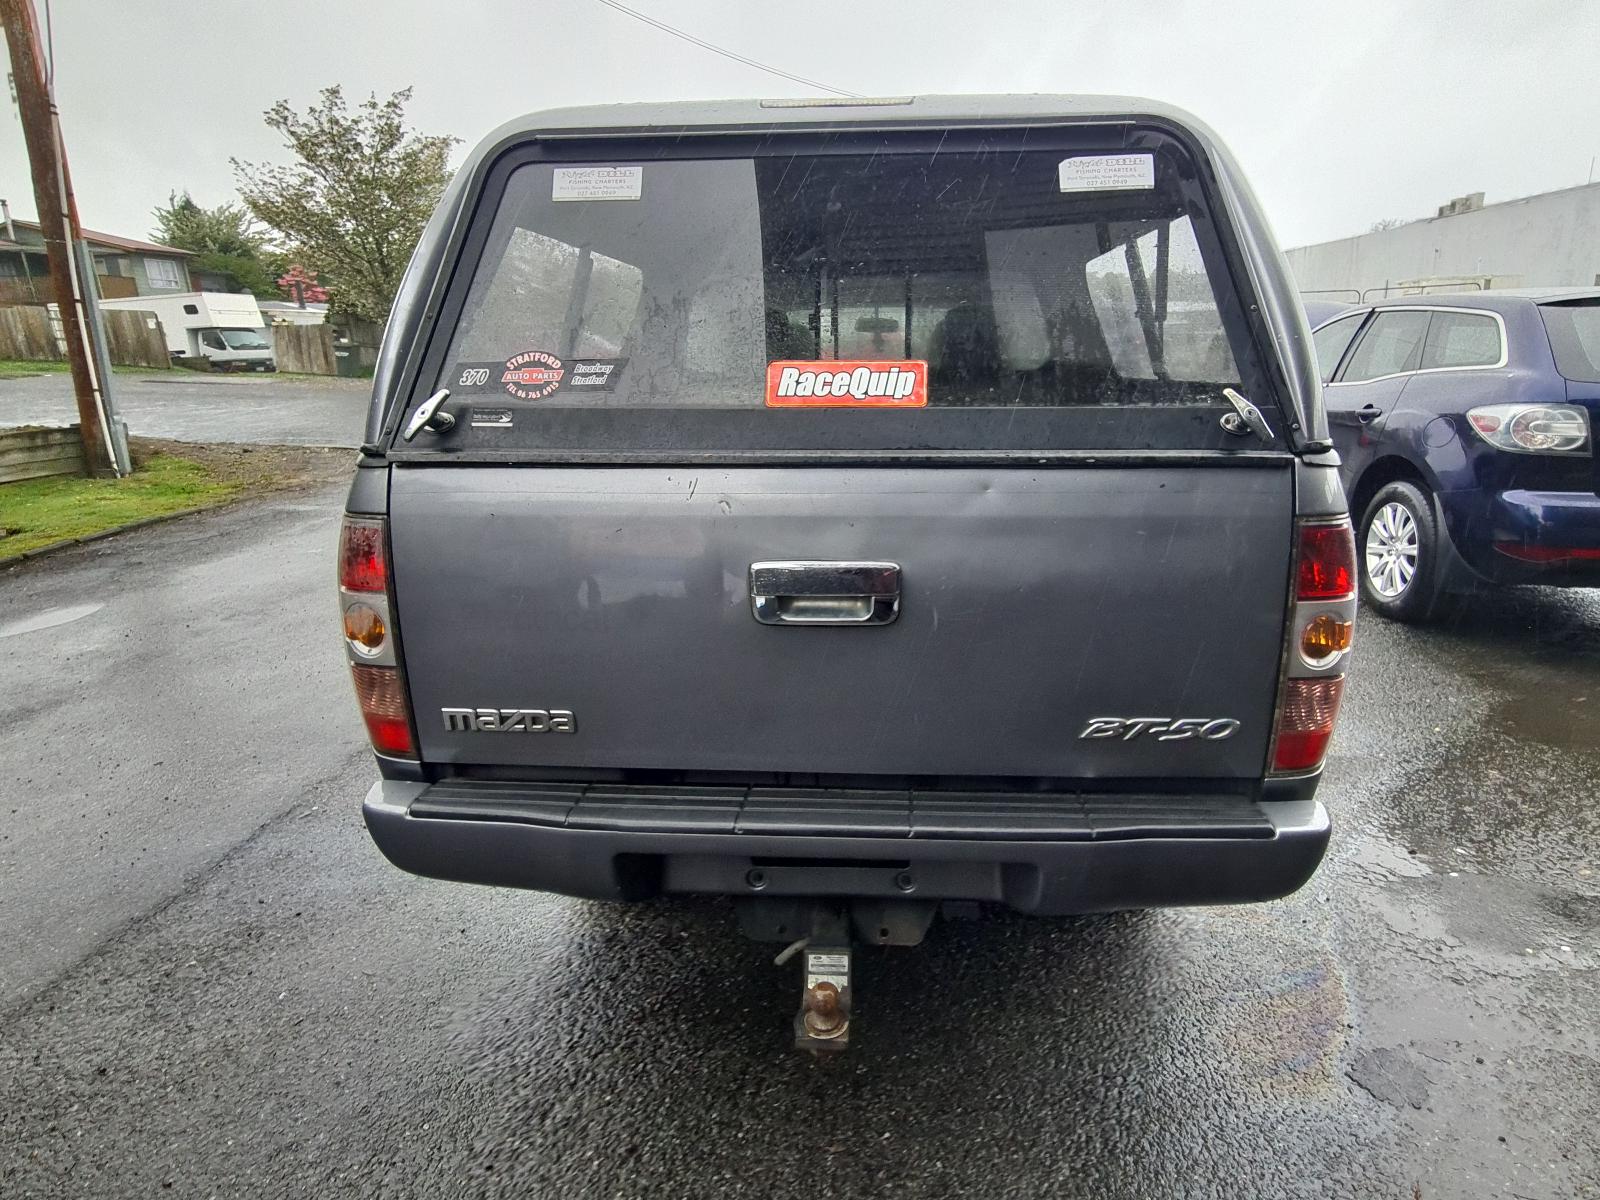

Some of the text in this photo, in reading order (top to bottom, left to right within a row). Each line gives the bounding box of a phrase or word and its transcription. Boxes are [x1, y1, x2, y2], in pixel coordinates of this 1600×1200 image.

[506, 352, 562, 370] STRATFORD
[573, 363, 614, 374] Broadway
[459, 369, 489, 386] 370
[532, 372, 559, 380] PARTS
[571, 374, 608, 385] Stratford
[776, 367, 916, 400] RaceQuip
[506, 382, 517, 394] TEL
[517, 389, 526, 398] 06
[528, 390, 541, 399] 765
[1078, 717, 1241, 740] BT-50
